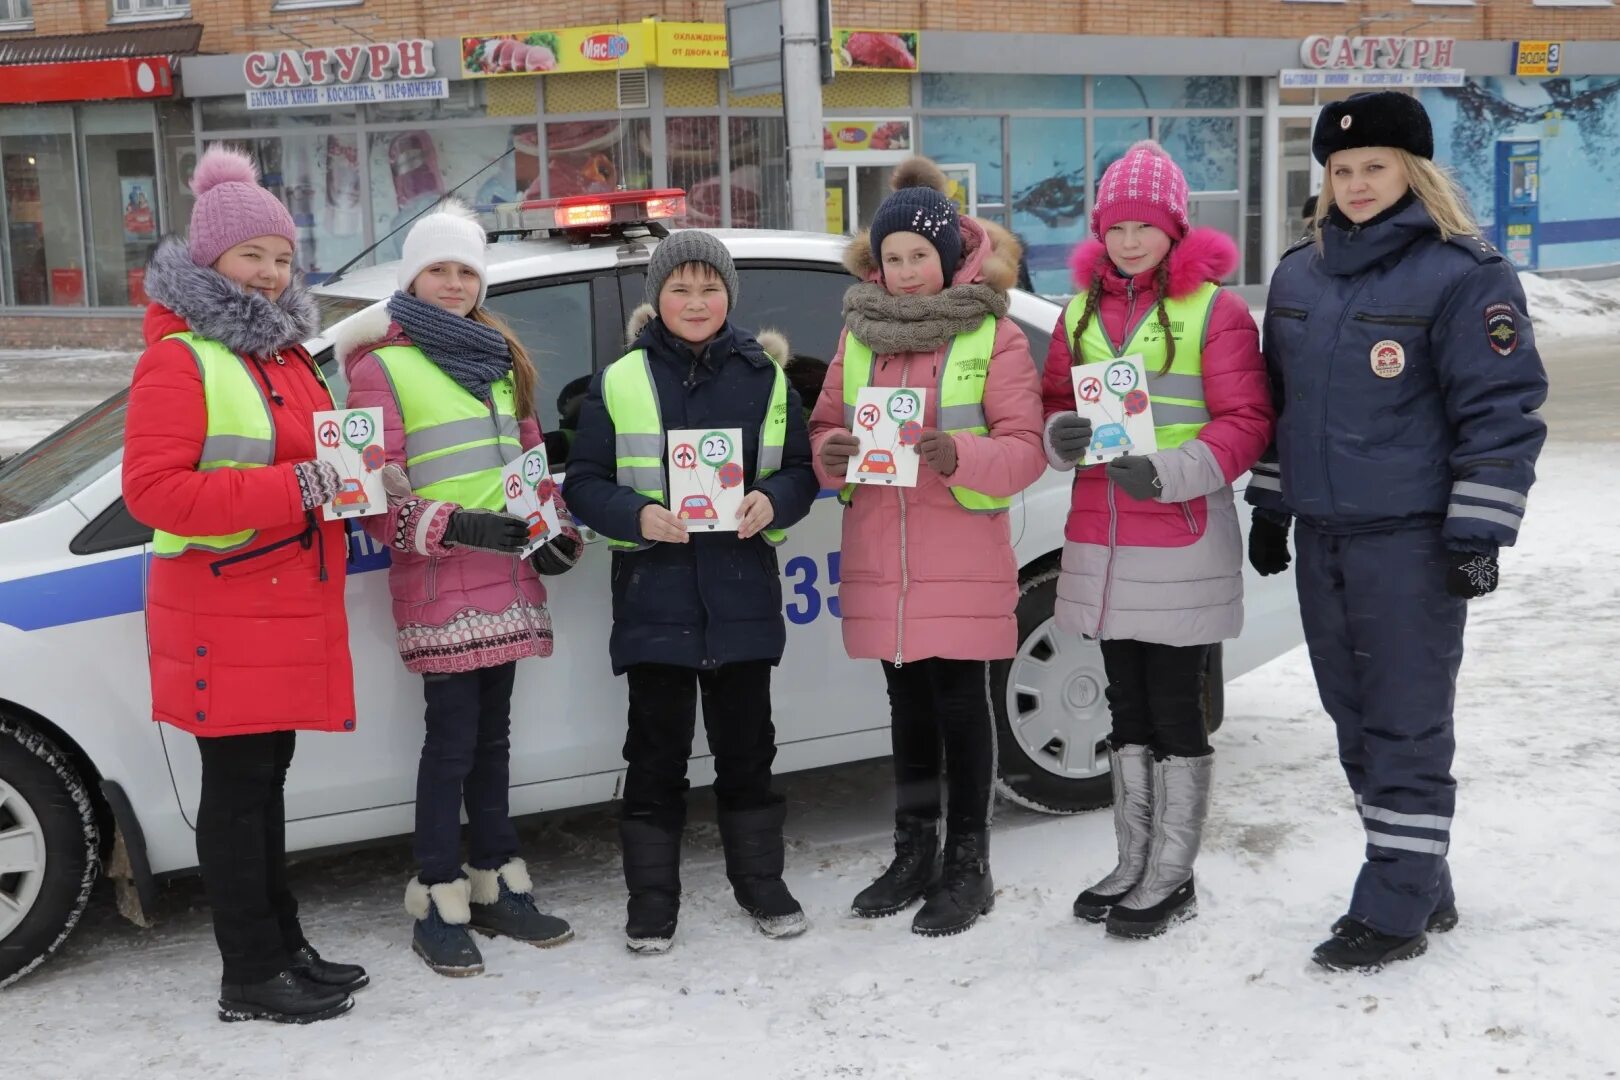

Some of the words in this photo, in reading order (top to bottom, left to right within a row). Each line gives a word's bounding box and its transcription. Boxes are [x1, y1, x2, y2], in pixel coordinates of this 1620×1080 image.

[1302, 36, 1455, 68] САТУРН
[244, 39, 436, 87] САТУРН
[250, 92, 288, 107] БЫТОВАЯ
[327, 84, 376, 103] КОСМЕТИКА
[384, 80, 443, 99] ПАРФЮМЕРИЯ
[1111, 369, 1131, 386] 23
[893, 396, 913, 414] 23
[349, 418, 369, 438] 23
[705, 439, 727, 457] 23
[527, 457, 541, 476] 23
